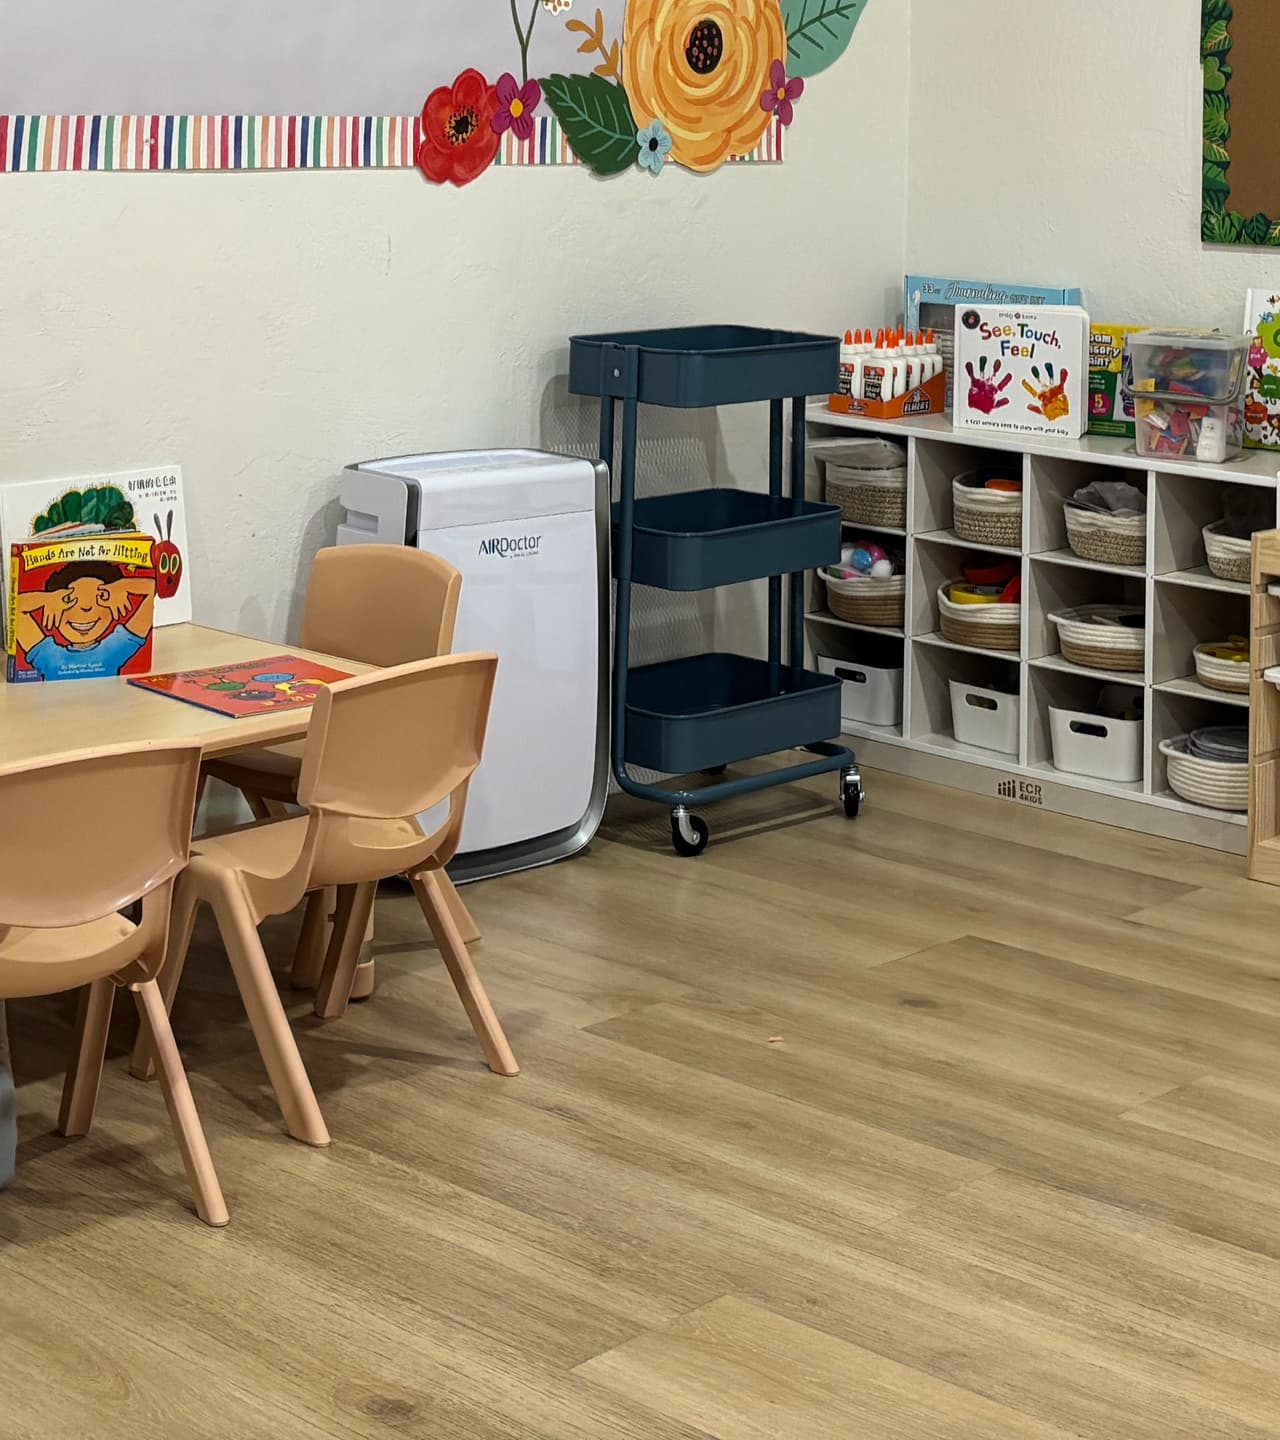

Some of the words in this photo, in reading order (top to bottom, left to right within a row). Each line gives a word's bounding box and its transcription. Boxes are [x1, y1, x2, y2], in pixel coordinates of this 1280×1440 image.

[979, 322, 1016, 340] See,
[1017, 323, 1061, 349] Touch,
[1000, 340, 1035, 359] Feel
[1094, 393, 1104, 408] 5
[25, 549, 56, 566] Hands
[58, 548, 75, 560] Are
[78, 544, 96, 558] Not
[98, 544, 111, 556] for
[113, 543, 148, 563] Hitting
[1019, 781, 1042, 796] ECR
[1019, 793, 1043, 805] 4KIDS
